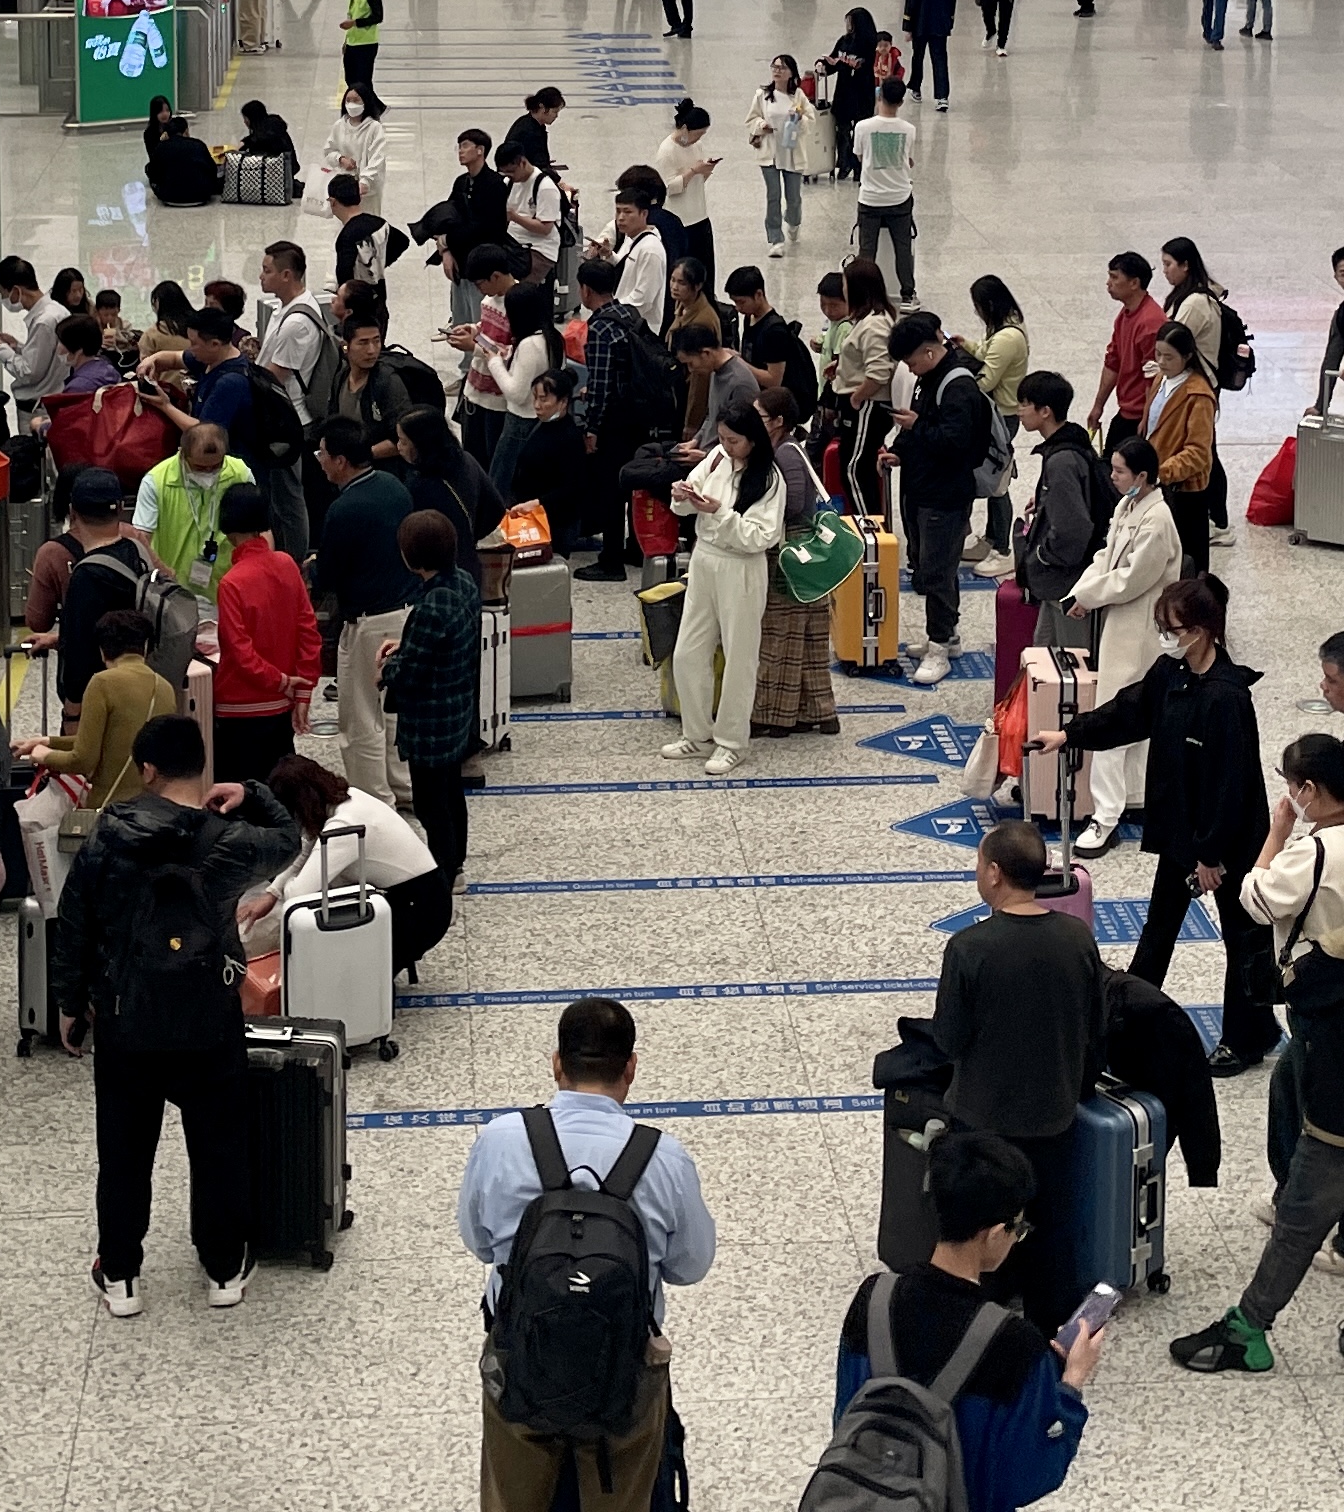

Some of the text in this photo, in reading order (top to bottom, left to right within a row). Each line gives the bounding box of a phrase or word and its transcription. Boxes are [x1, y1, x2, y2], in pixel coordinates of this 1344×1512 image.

[783, 875, 844, 885] Self-service
[846, 872, 923, 883] ticket-checking
[924, 872, 965, 881] channel
[483, 994, 519, 1004] Please
[521, 993, 546, 1002] don't
[548, 992, 582, 1001] collide
[623, 991, 632, 999] in
[633, 990, 655, 998] turn
[815, 982, 881, 992] Self-service
[643, 1106, 652, 1114] in
[654, 1105, 678, 1114] turn
